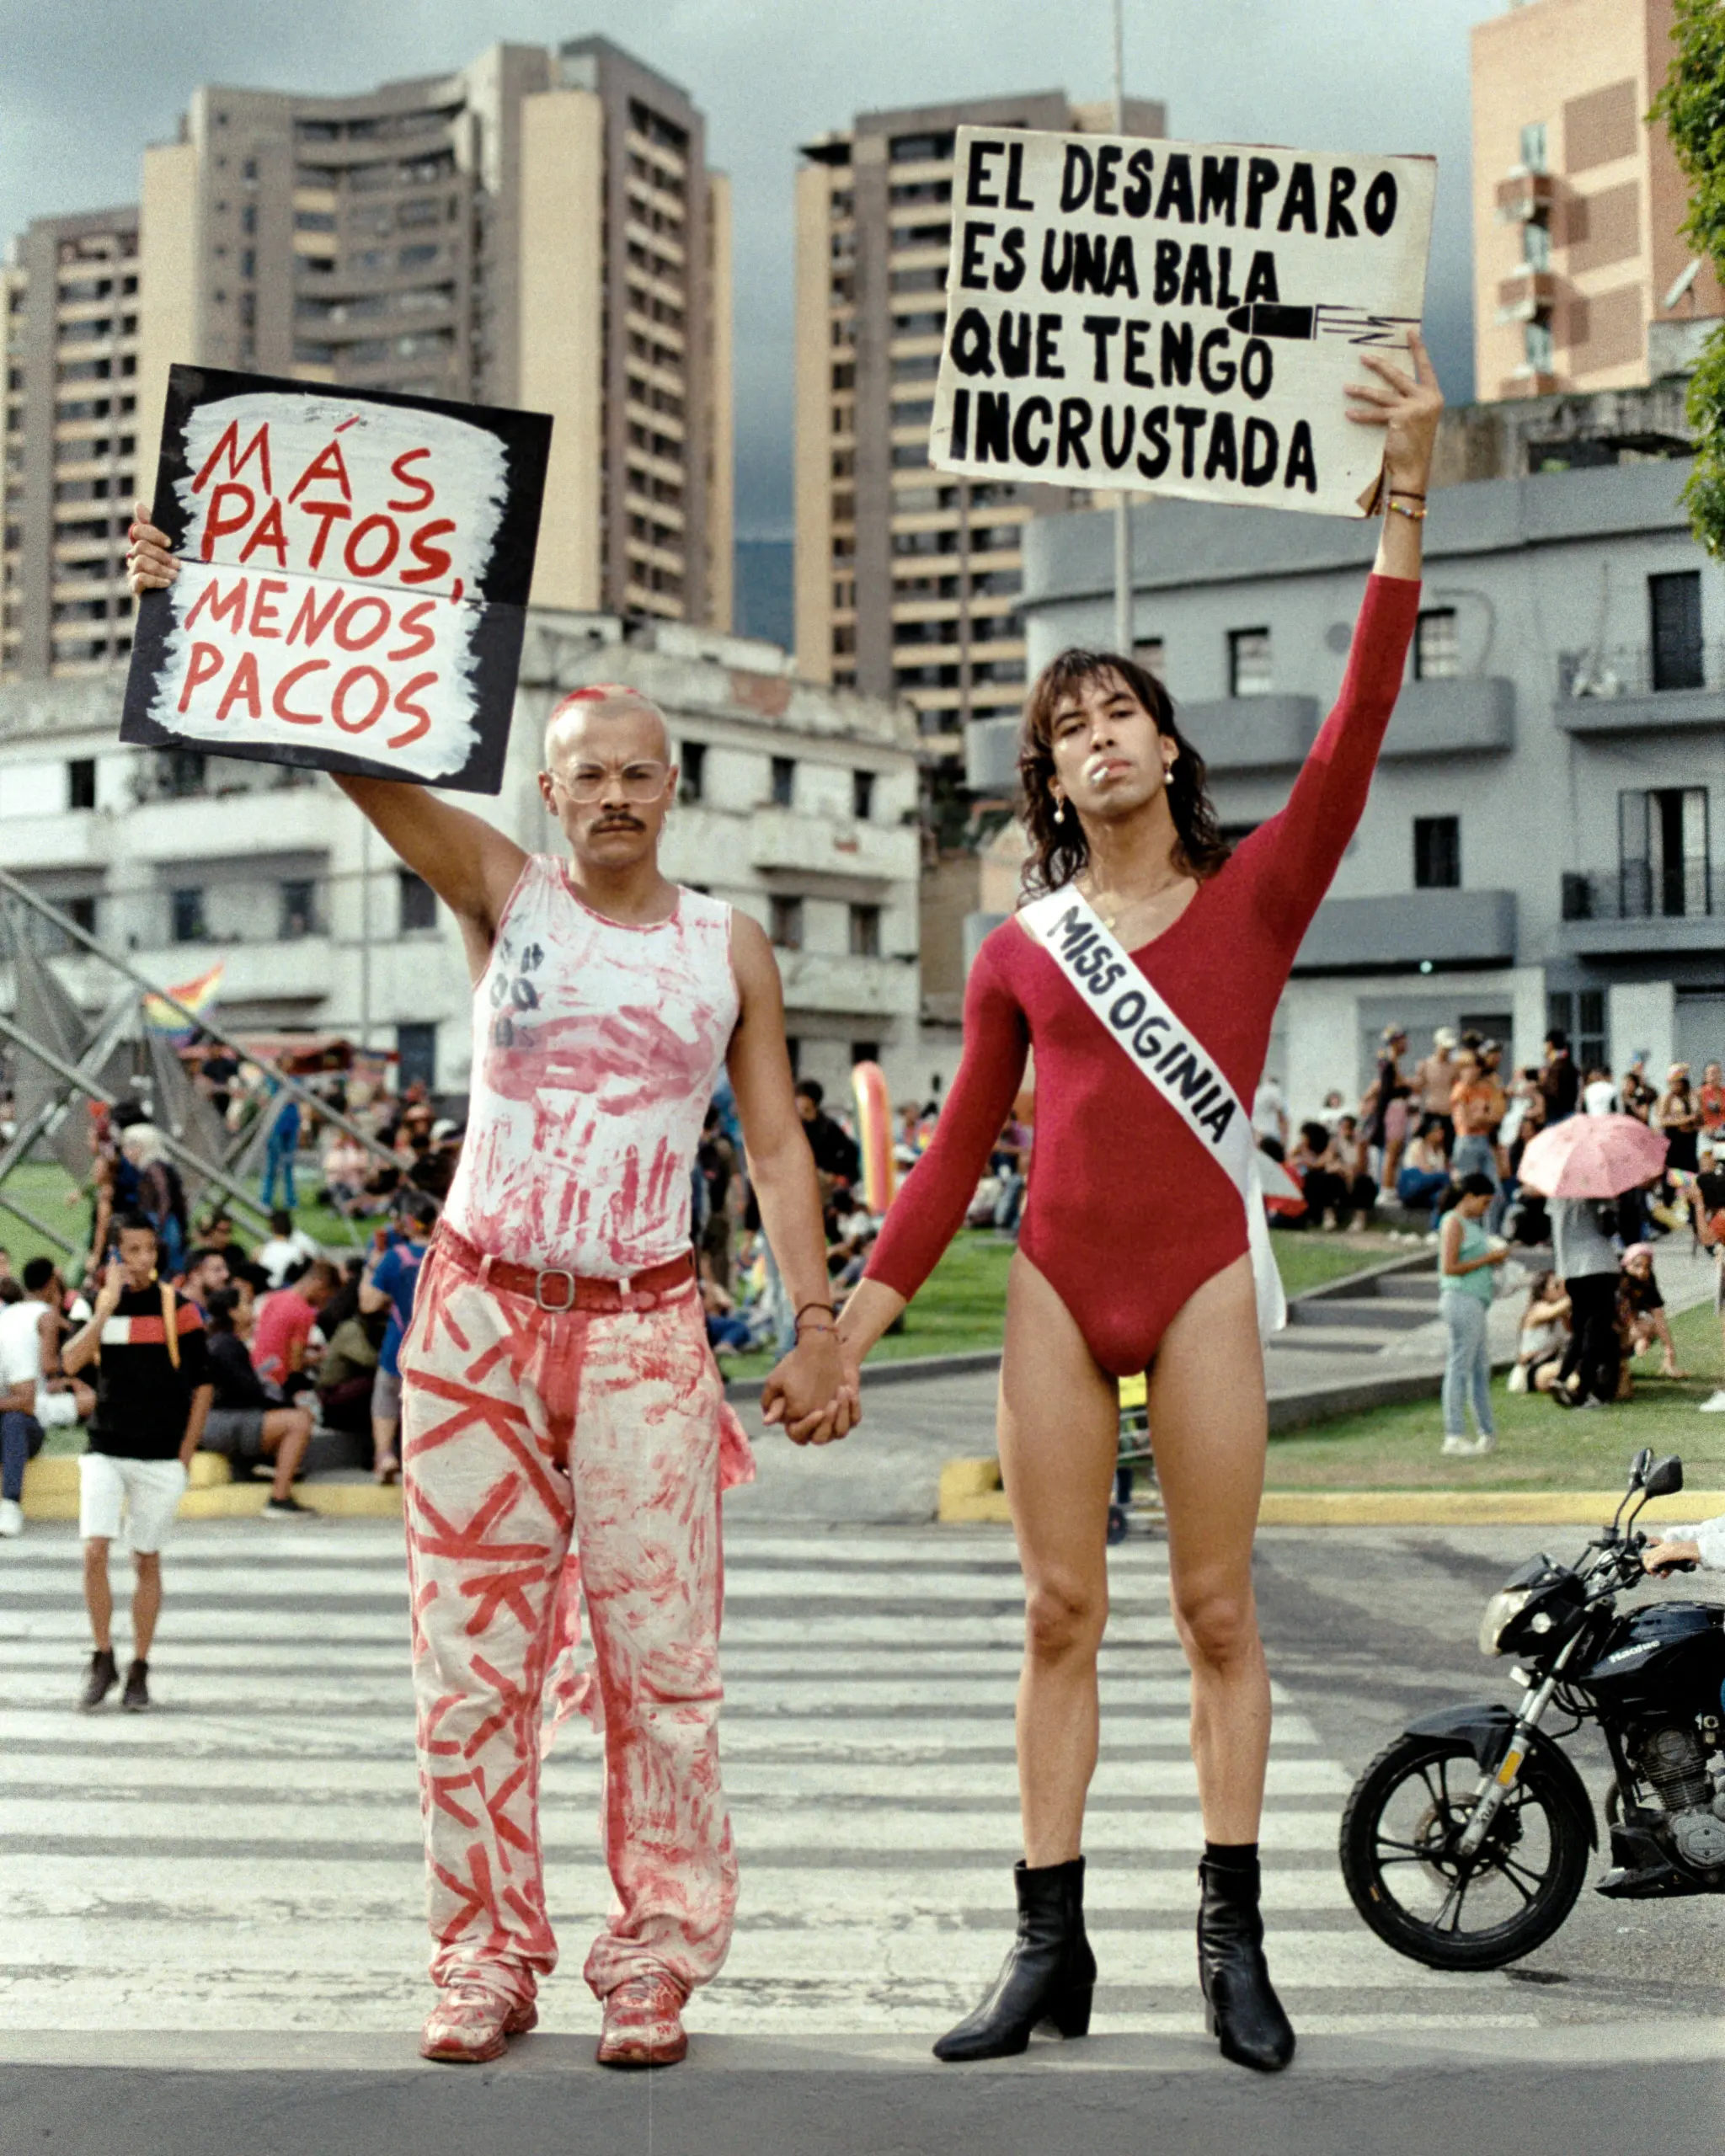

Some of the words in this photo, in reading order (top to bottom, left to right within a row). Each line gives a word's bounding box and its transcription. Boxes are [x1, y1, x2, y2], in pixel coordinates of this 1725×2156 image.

[965, 141, 1035, 211] EL
[1059, 144, 1398, 239] DESAMPARO
[959, 222, 1027, 292] ES
[1040, 227, 1139, 299] UNA
[1153, 238, 1280, 310] BALA
[949, 307, 1065, 379] QUE
[1083, 314, 1274, 400] TENGO
[191, 415, 435, 512] MÁS
[948, 388, 1317, 494] INCRUSTADA
[200, 483, 465, 605] PATOS,
[184, 576, 436, 661] MENOS
[177, 641, 439, 750] PACOS
[1046, 905, 1127, 996] MISS
[1108, 990, 1237, 1145] OGINIA
